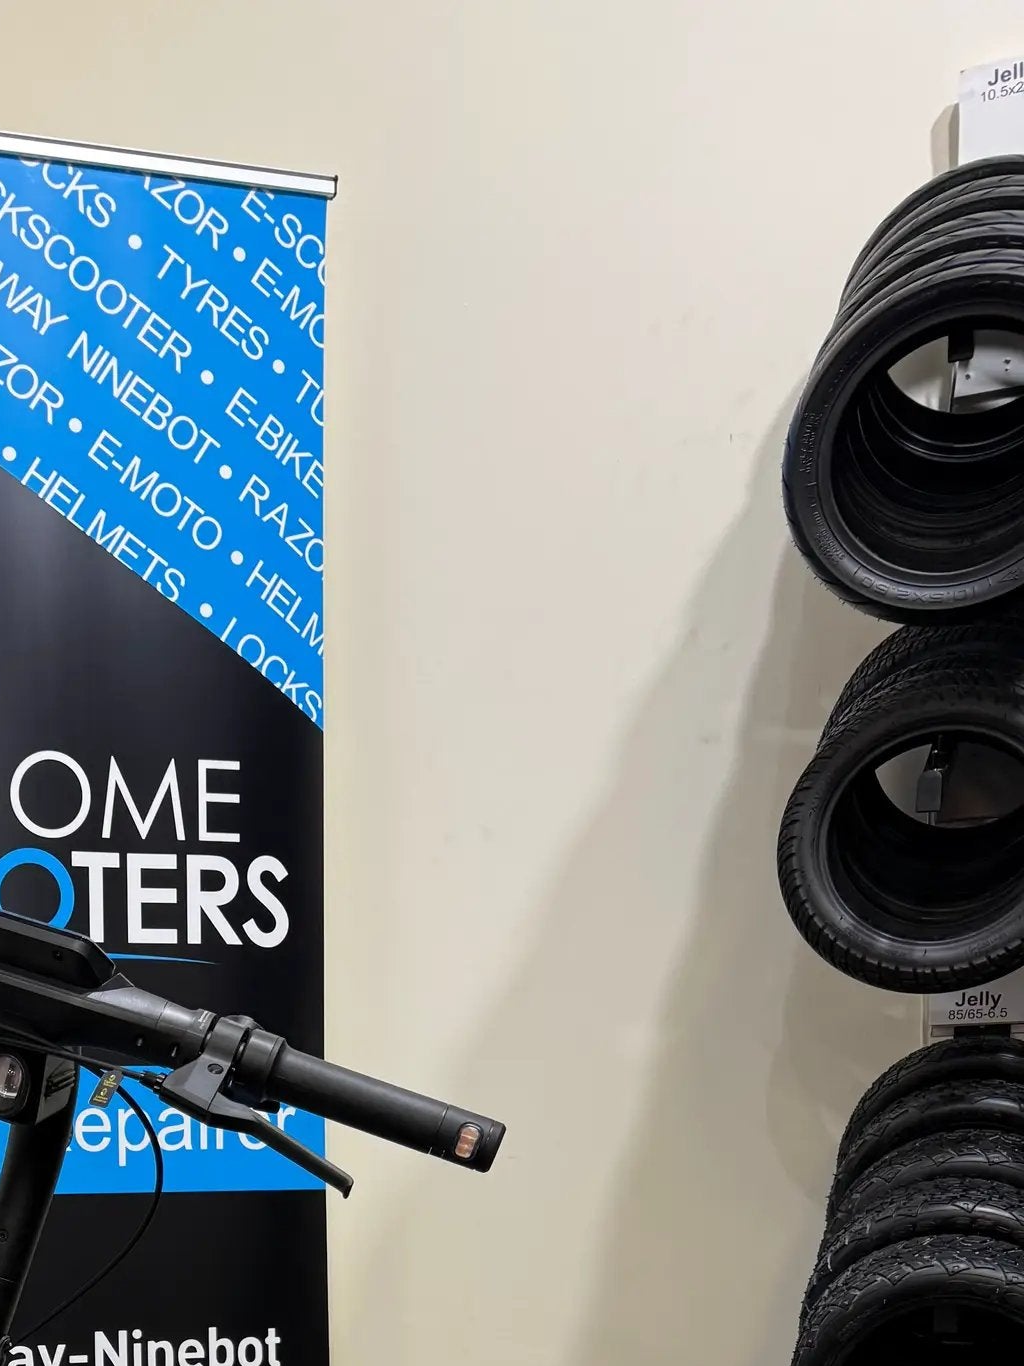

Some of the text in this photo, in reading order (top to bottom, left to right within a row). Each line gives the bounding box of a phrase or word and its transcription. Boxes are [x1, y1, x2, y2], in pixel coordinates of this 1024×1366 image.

[988, 61, 1024, 86] Jell
[22, 160, 116, 228] CKS
[157, 243, 269, 360] TYRES
[144, 176, 229, 251] ZOR
[67, 330, 220, 464] NINEBOT
[224, 386, 324, 499] E-BIKE
[20, 456, 186, 603] HELMETS
[87, 429, 223, 550] E-MOTO
[948, 1007, 1008, 1020] 85/65-6.5
[955, 991, 1002, 1010] Jelly
